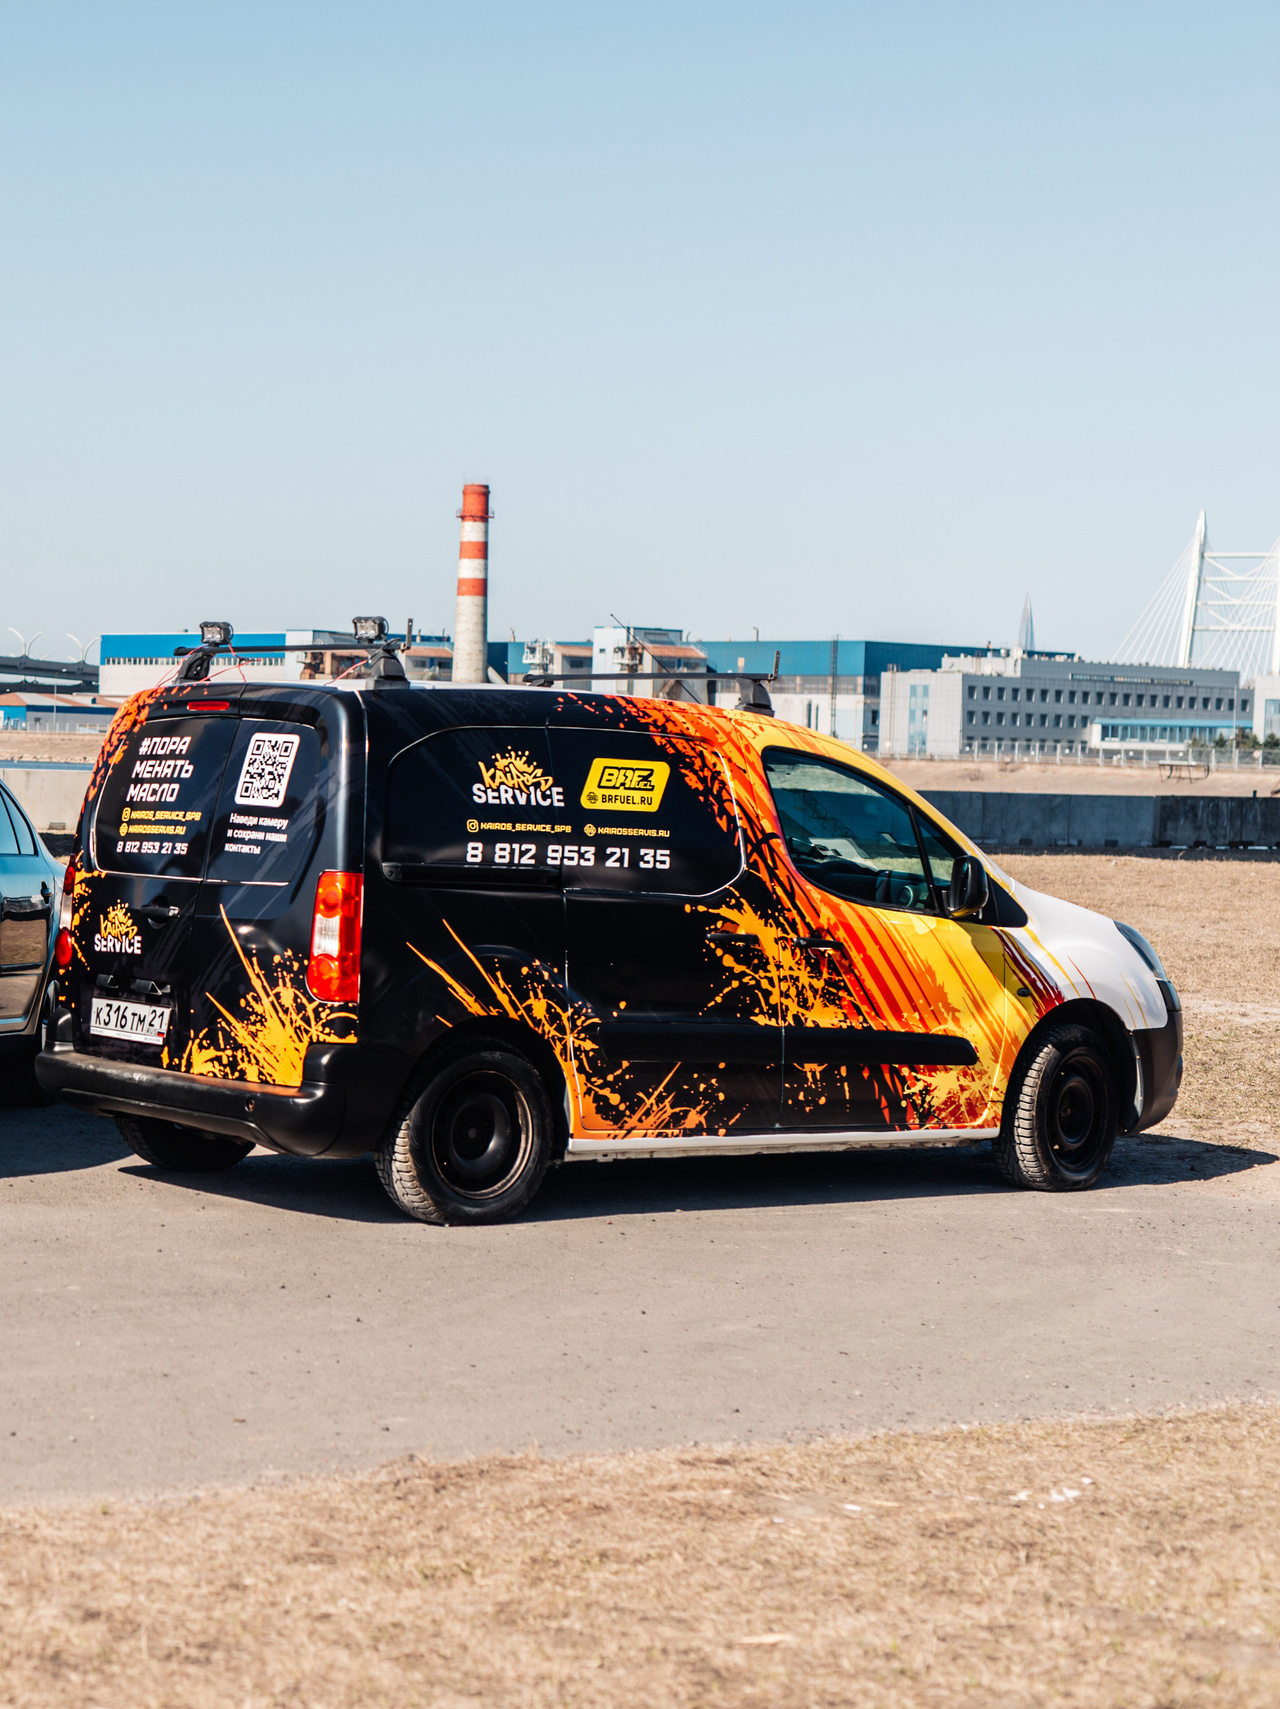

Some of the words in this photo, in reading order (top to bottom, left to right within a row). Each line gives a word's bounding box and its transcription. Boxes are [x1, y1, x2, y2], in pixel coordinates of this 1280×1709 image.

[139, 736, 191, 755] #ПОРА
[131, 760, 194, 778] МЕНЯТЬ
[126, 783, 180, 802] МАСЛО
[472, 783, 565, 807] SERVICE
[601, 794, 653, 806] BRFUEL.RU
[230, 813, 258, 826] Наведи
[258, 817, 289, 830] камеру
[480, 822, 572, 834] KAIROS_SERVICE_SPB
[233, 829, 265, 841] сохрани
[265, 832, 287, 842] наши
[597, 826, 670, 837] KAIROSSERVIS.RU
[116, 841, 124, 853] 8
[124, 841, 140, 853] 812
[141, 841, 160, 854] 953
[161, 842, 173, 854] 21
[173, 843, 188, 855] 35
[224, 843, 261, 854] контакты
[466, 842, 483, 863] 8
[494, 843, 537, 864] 812
[546, 845, 596, 867] 953
[605, 847, 629, 868] 21
[639, 849, 670, 869] 35
[94, 934, 142, 954] SERVICE
[148, 1009, 165, 1029] 21
